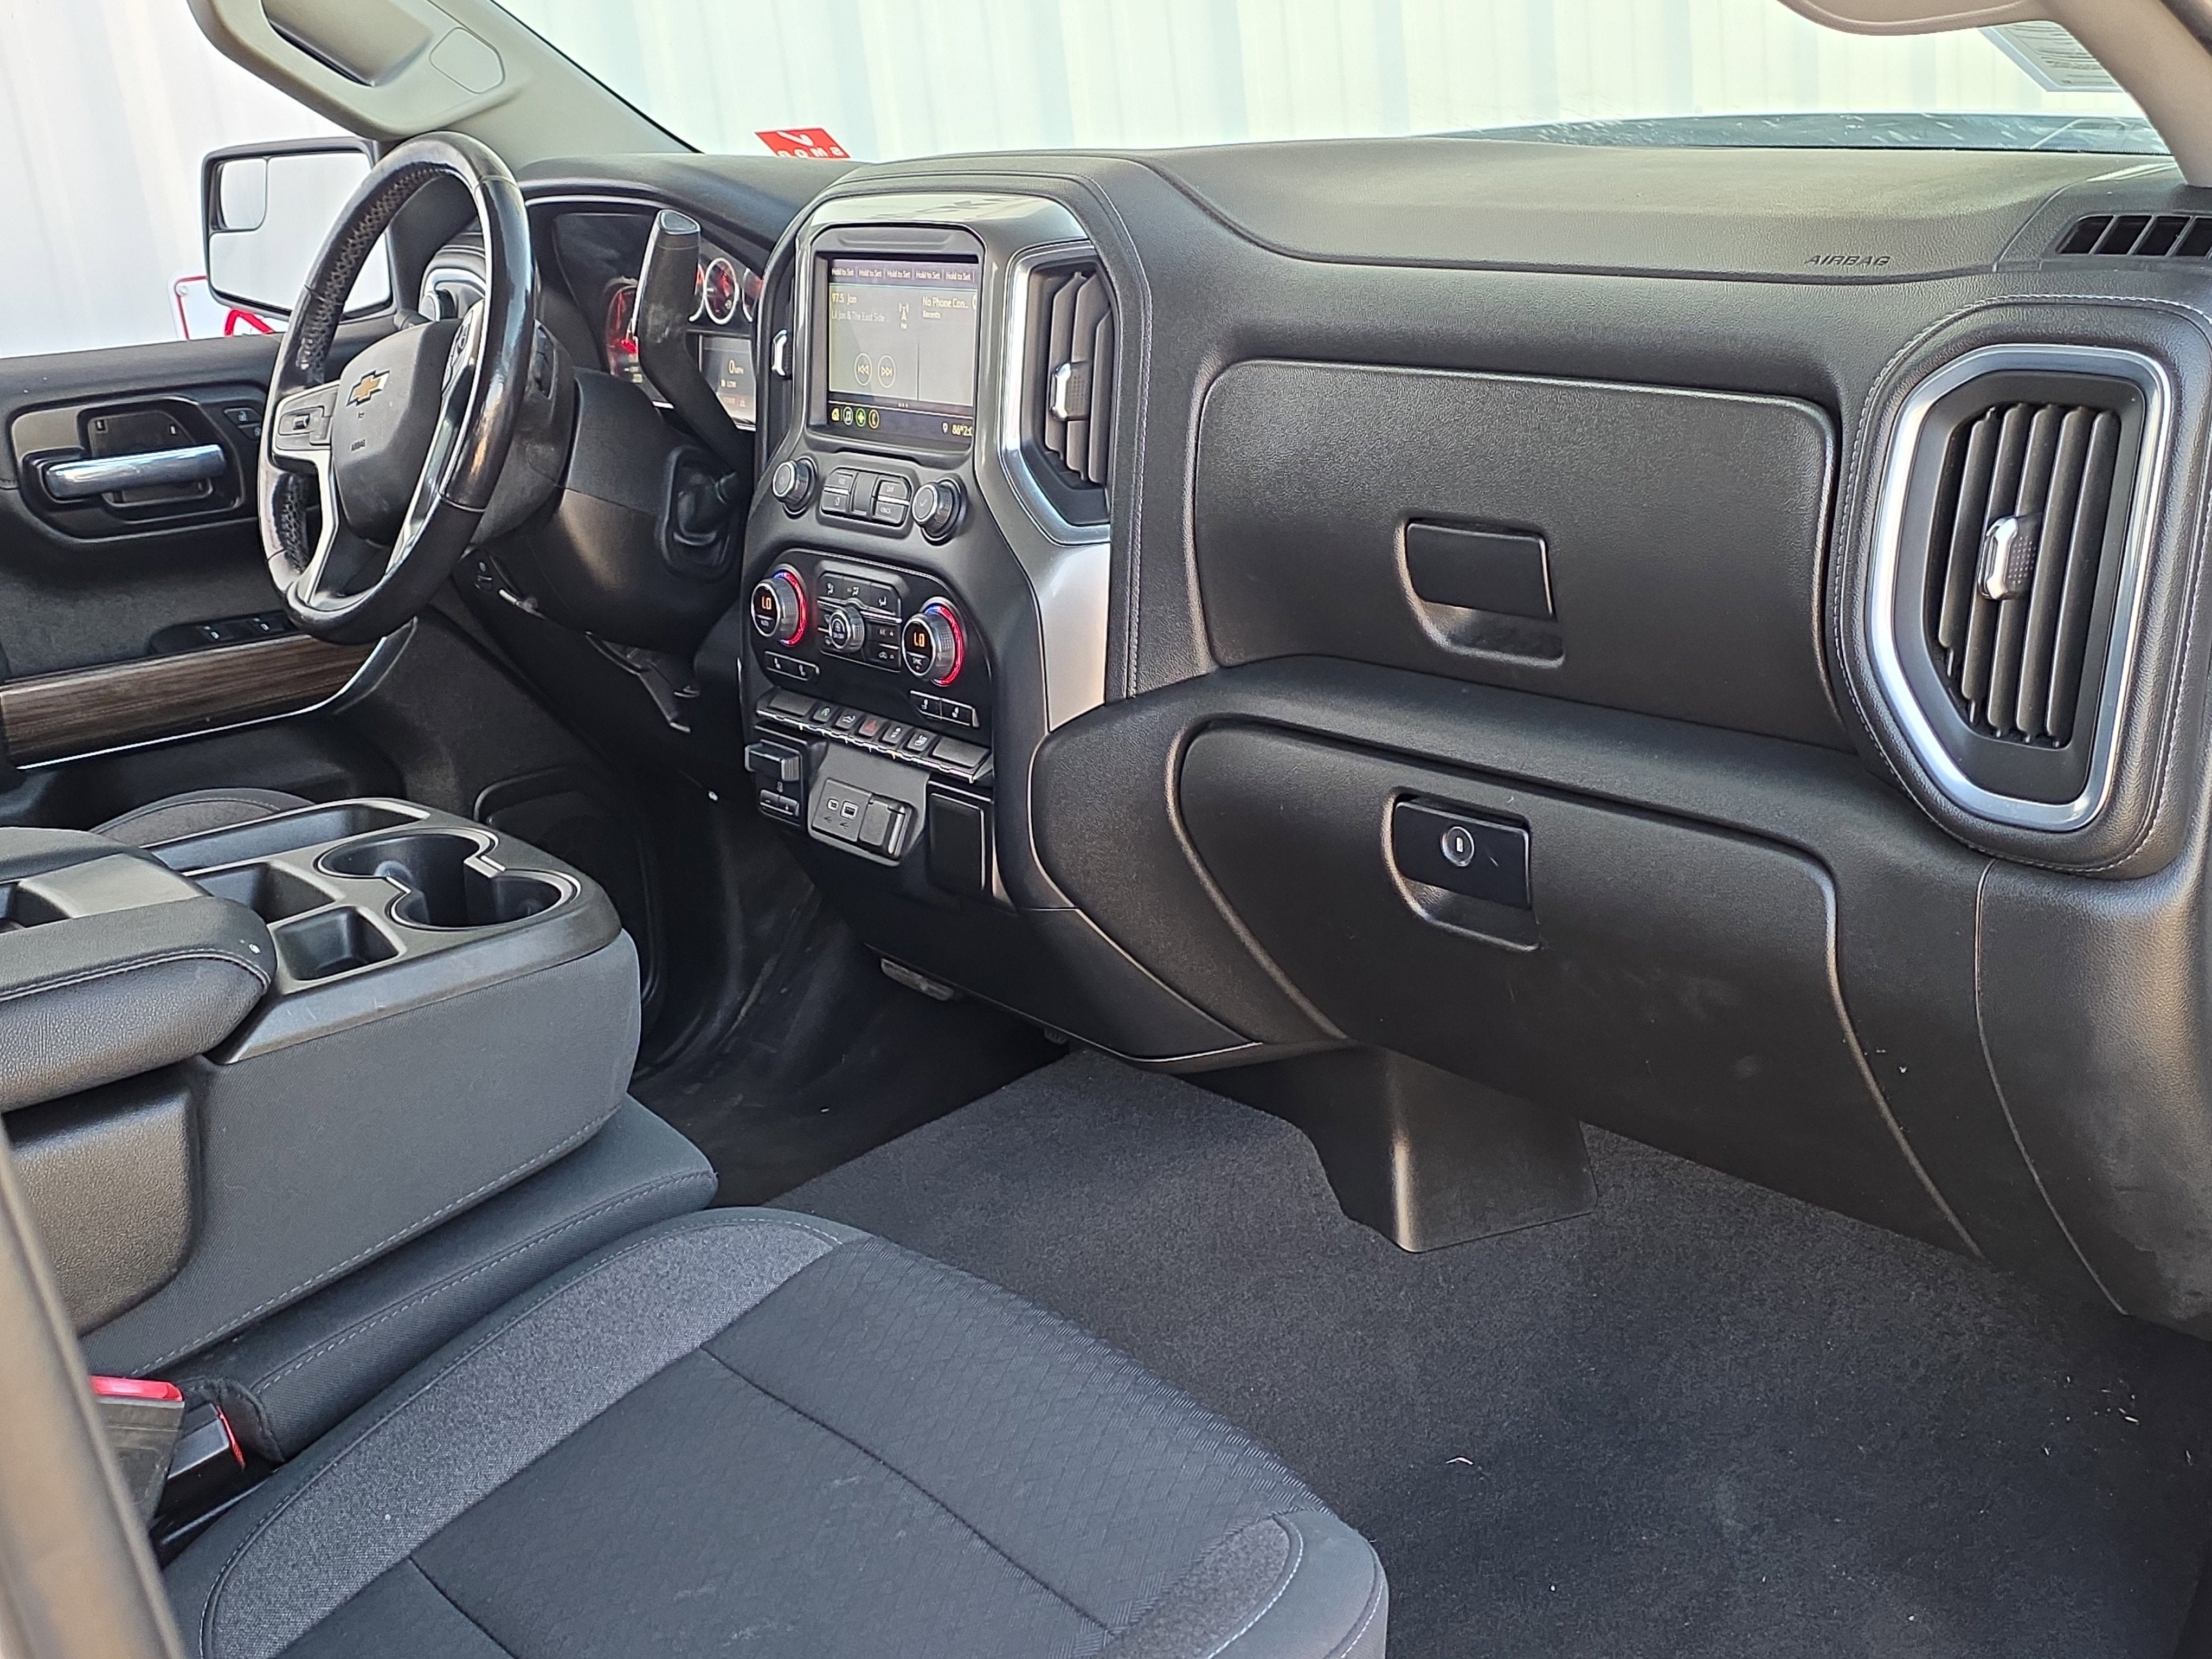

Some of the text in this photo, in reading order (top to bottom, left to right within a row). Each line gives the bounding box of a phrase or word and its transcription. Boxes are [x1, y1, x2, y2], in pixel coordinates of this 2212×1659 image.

[1804, 255, 1892, 266] AIRBAG
[923, 296, 931, 307] No
[933, 297, 951, 307] Phone
[762, 596, 772, 610] LO
[914, 632, 925, 647] LO
